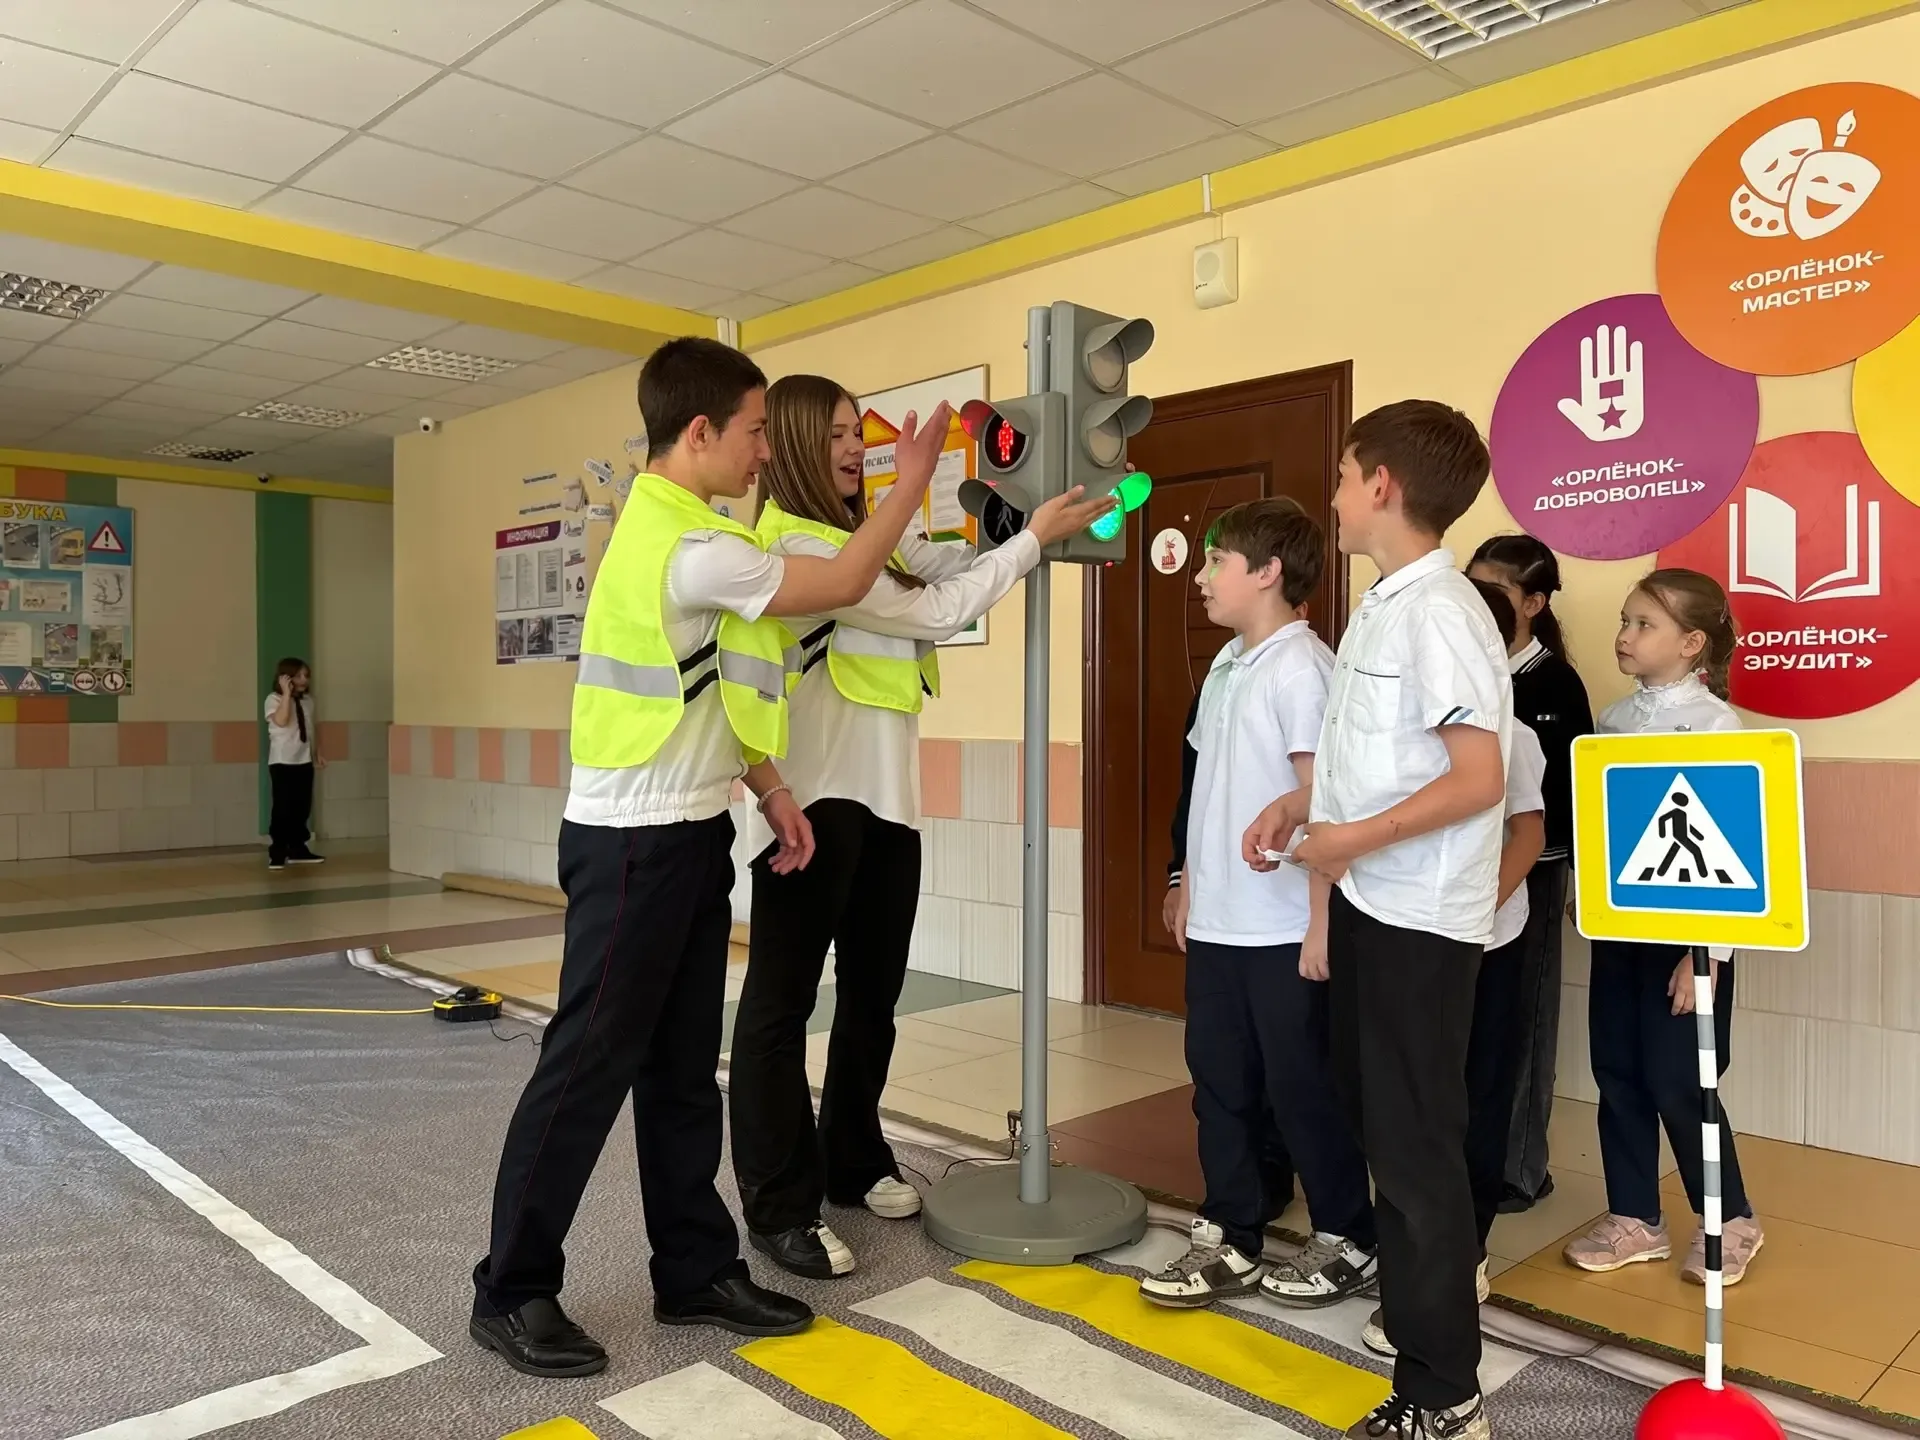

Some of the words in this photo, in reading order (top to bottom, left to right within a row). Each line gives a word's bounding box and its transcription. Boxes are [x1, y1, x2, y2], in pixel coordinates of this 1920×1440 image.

[1728, 249, 1885, 293] «ОРЛЁНОК-
[1743, 278, 1872, 314] МАСТЕР»
[864, 454, 896, 468] психо
[1551, 457, 1685, 488] «ОРЛЁНОК-
[1533, 478, 1706, 511] ДОБРОВОЛЕЦ»
[0, 502, 68, 521] БУКА
[506, 525, 549, 544] ИНФОРМАЦИЯ
[1735, 626, 1888, 647] «ОРЛЁНОК-
[1743, 652, 1873, 671] ЭРУДИТ»
